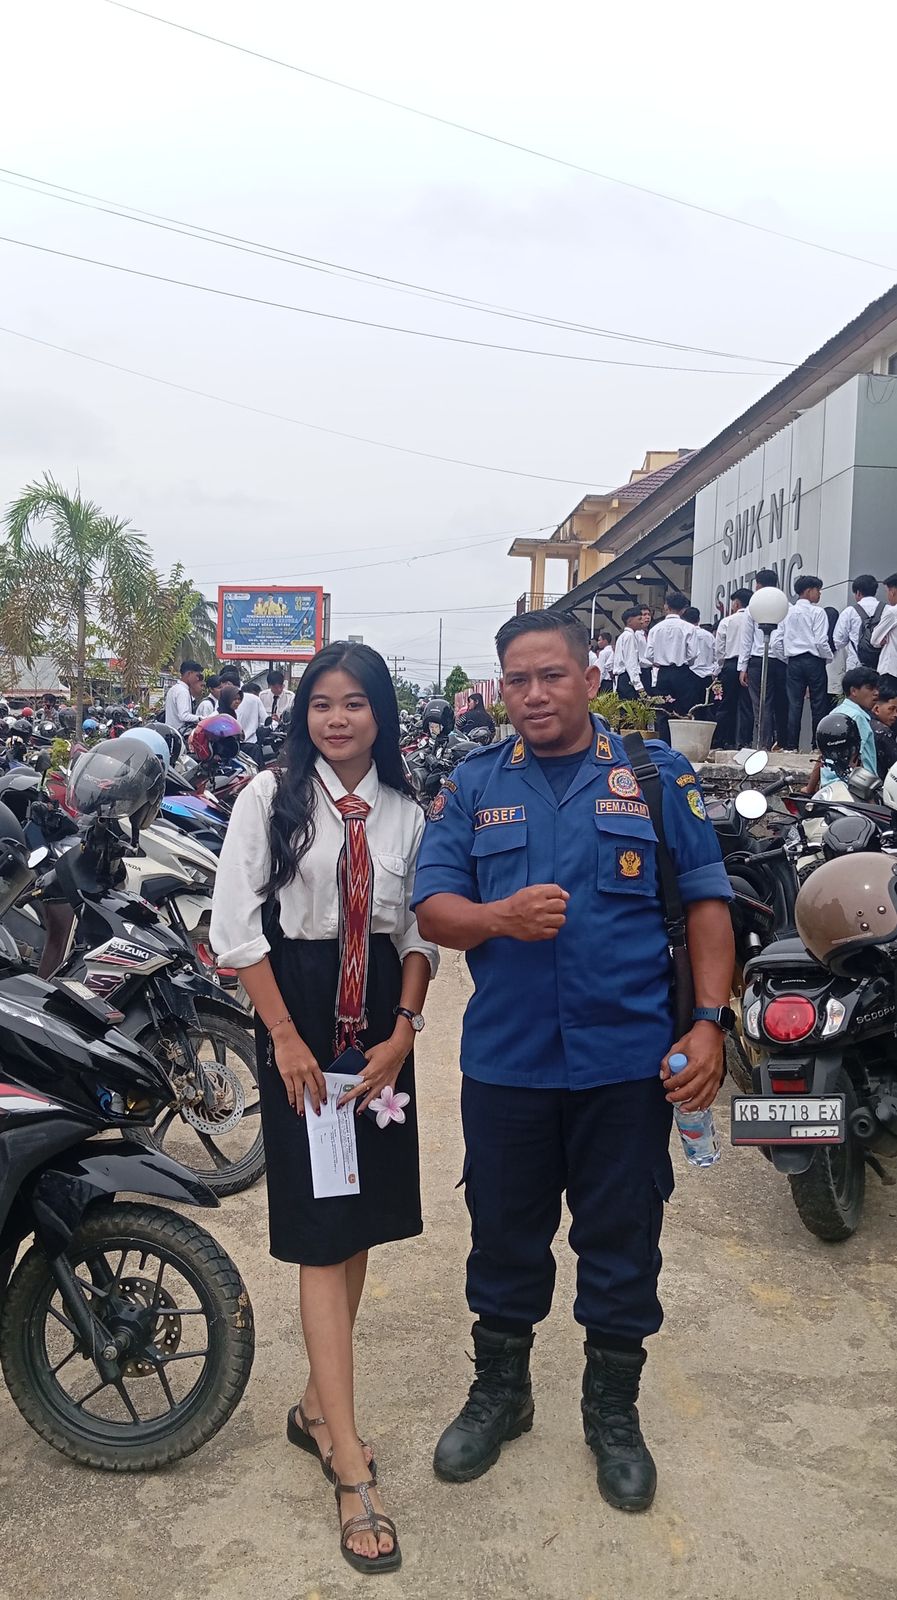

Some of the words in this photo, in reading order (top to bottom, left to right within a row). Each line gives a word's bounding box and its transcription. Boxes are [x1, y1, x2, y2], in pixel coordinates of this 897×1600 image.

[722, 499, 764, 565] SMK
[769, 488, 784, 543] N
[792, 477, 801, 531] 1
[714, 553, 803, 620] SINTNG
[478, 809, 516, 825] YOSEF
[600, 802, 647, 815] PEMADAM
[110, 941, 150, 959] SUZUKI
[739, 1105, 759, 1120] KB
[768, 1105, 809, 1120] 5718
[819, 1105, 838, 1120] EX
